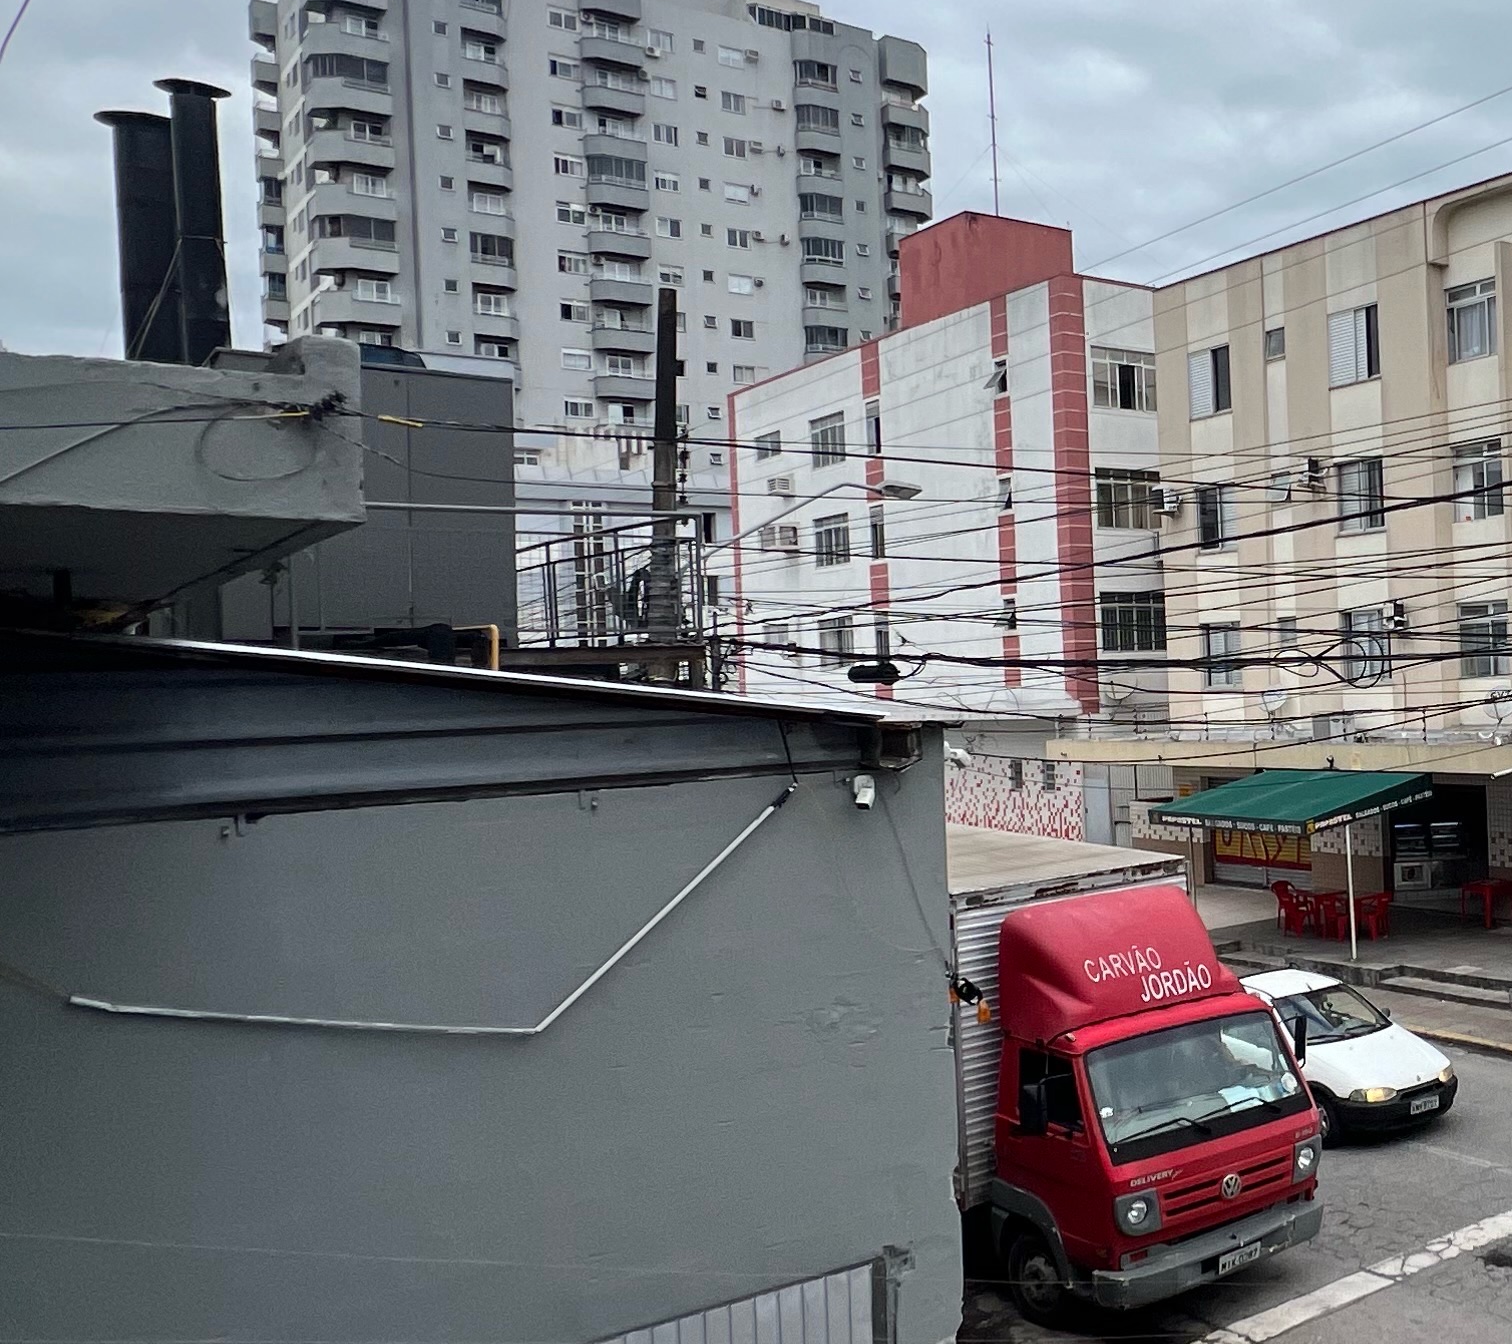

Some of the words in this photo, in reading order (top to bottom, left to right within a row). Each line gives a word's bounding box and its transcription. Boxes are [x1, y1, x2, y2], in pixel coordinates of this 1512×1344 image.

[1083, 945, 1162, 983] CARVÃO
[1140, 960, 1212, 1002] JORDÃO
[1130, 1168, 1174, 1187] DELIVERY
